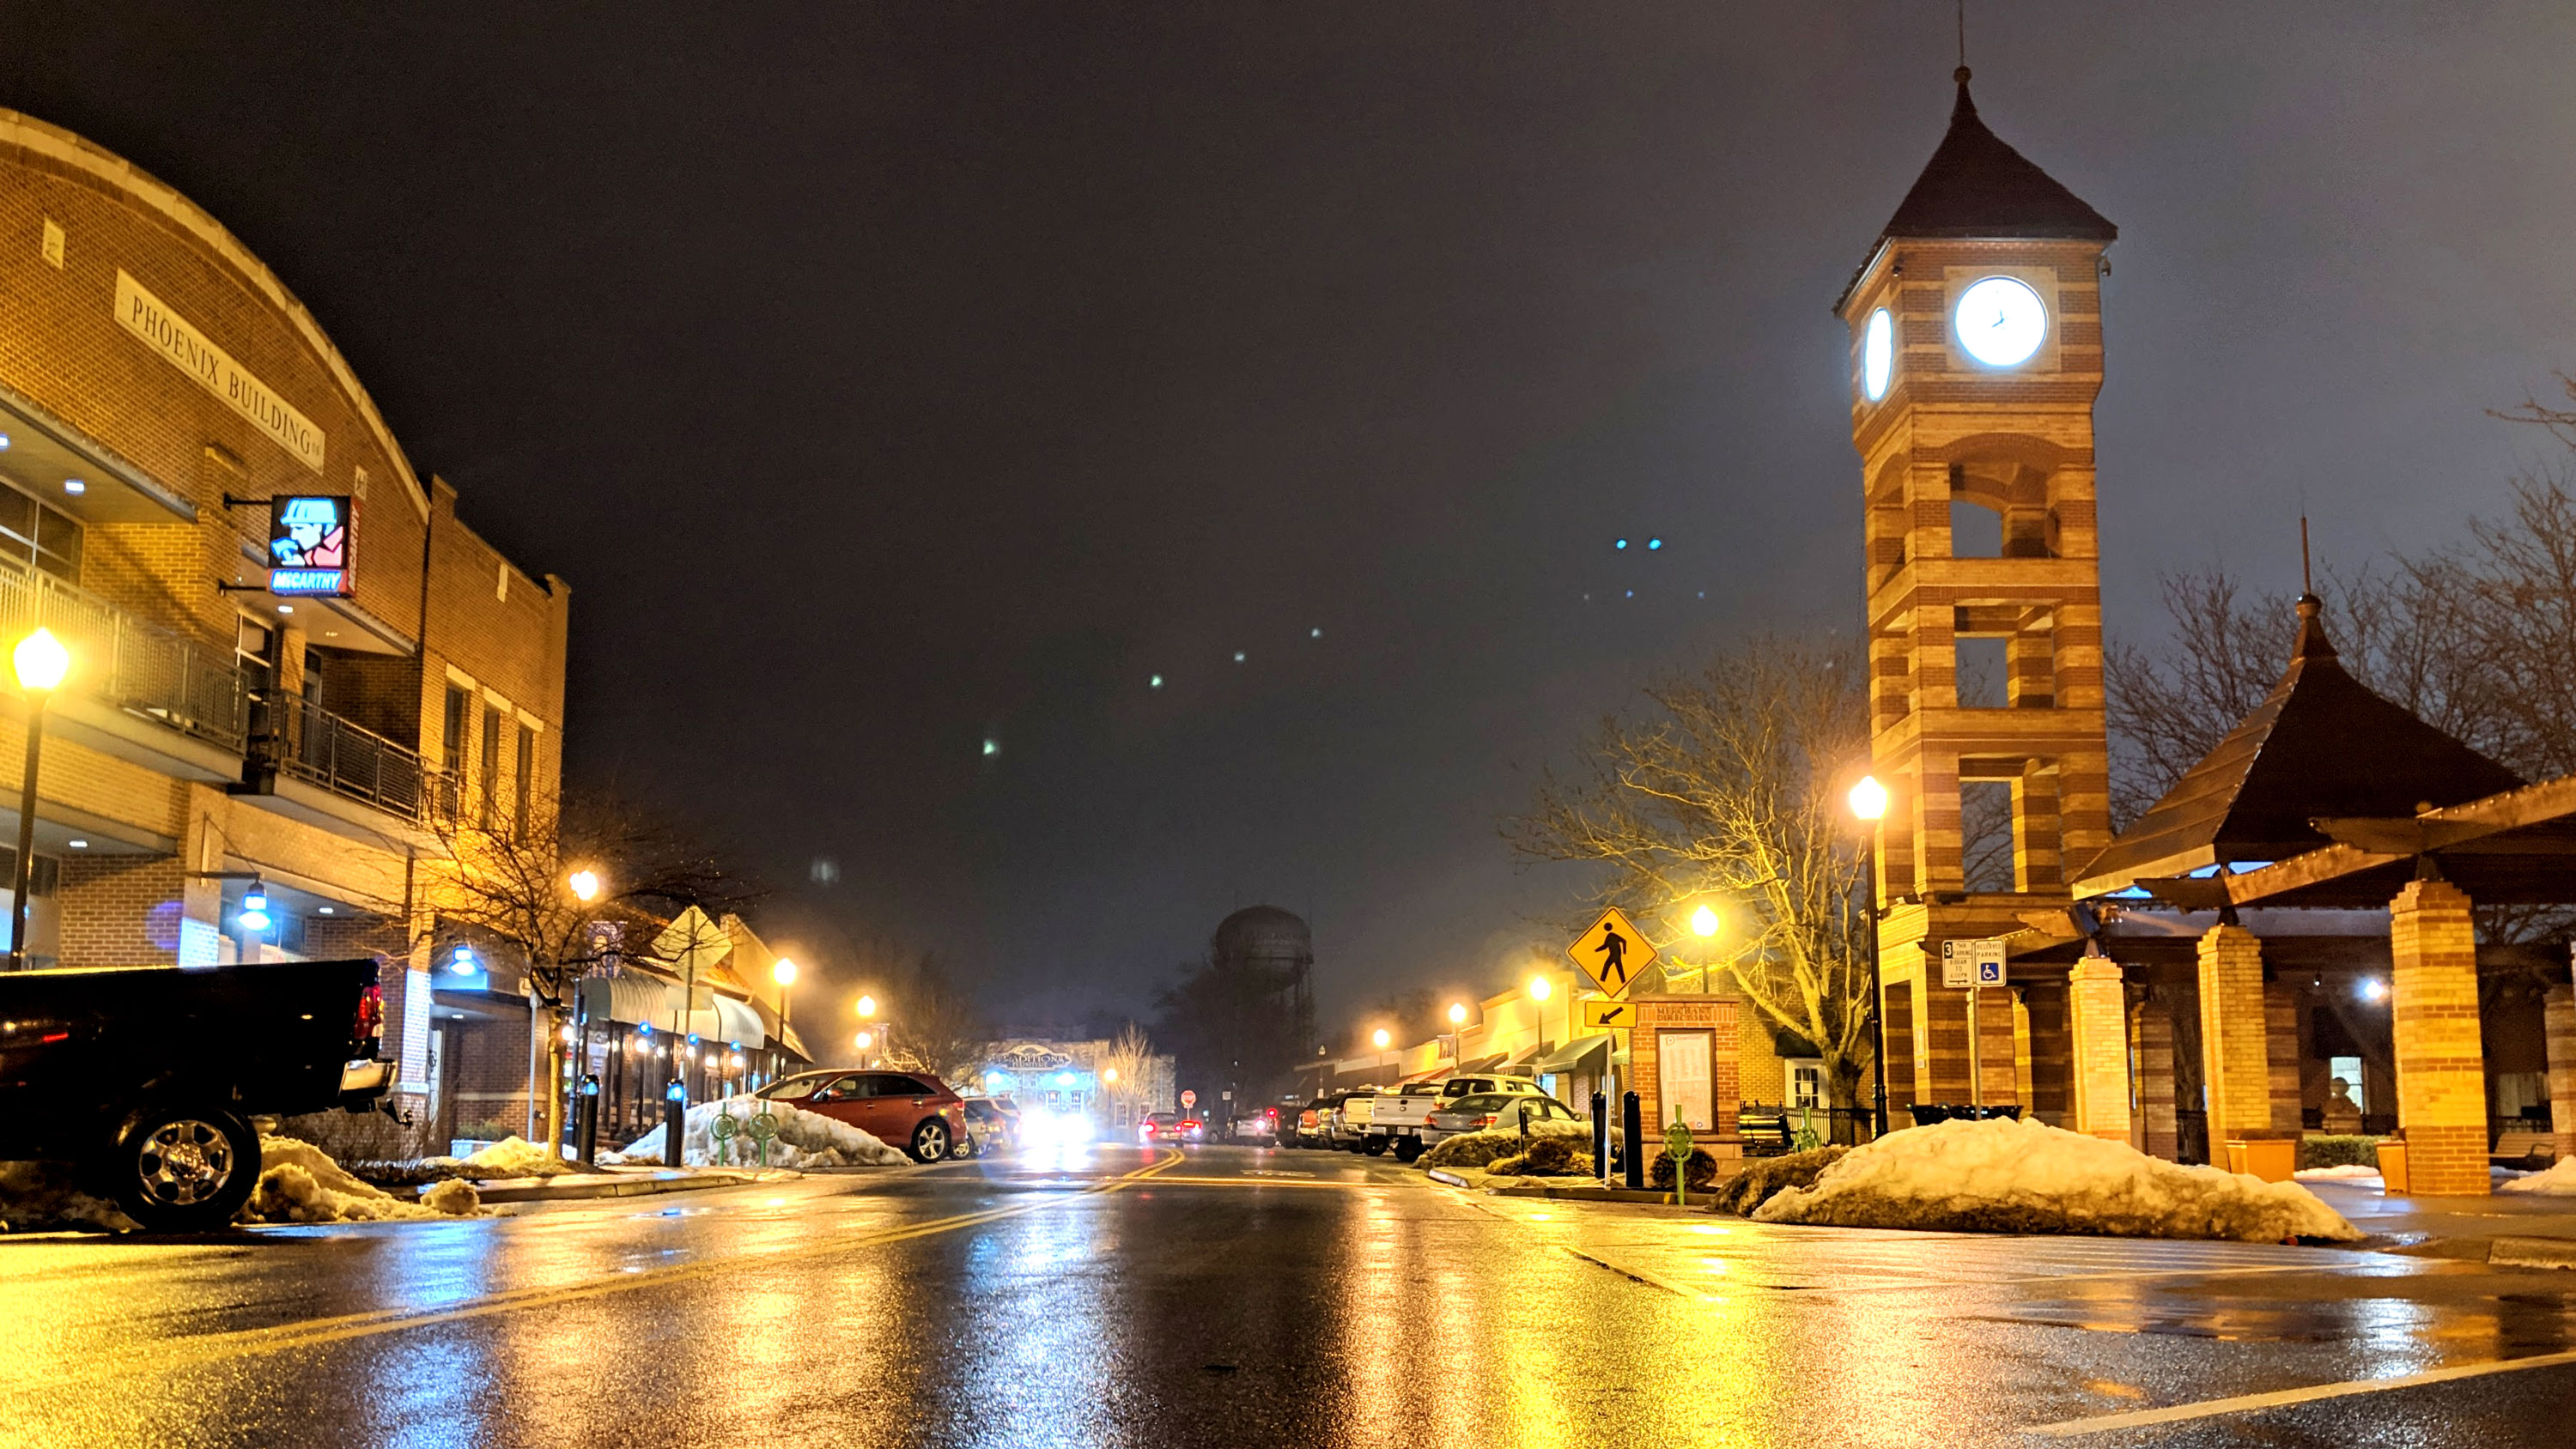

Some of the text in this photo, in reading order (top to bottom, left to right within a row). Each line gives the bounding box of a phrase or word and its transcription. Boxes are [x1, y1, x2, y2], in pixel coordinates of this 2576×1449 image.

[132, 294, 311, 455] PHOENIX BUILDING
[1945, 943, 1952, 956] 3
